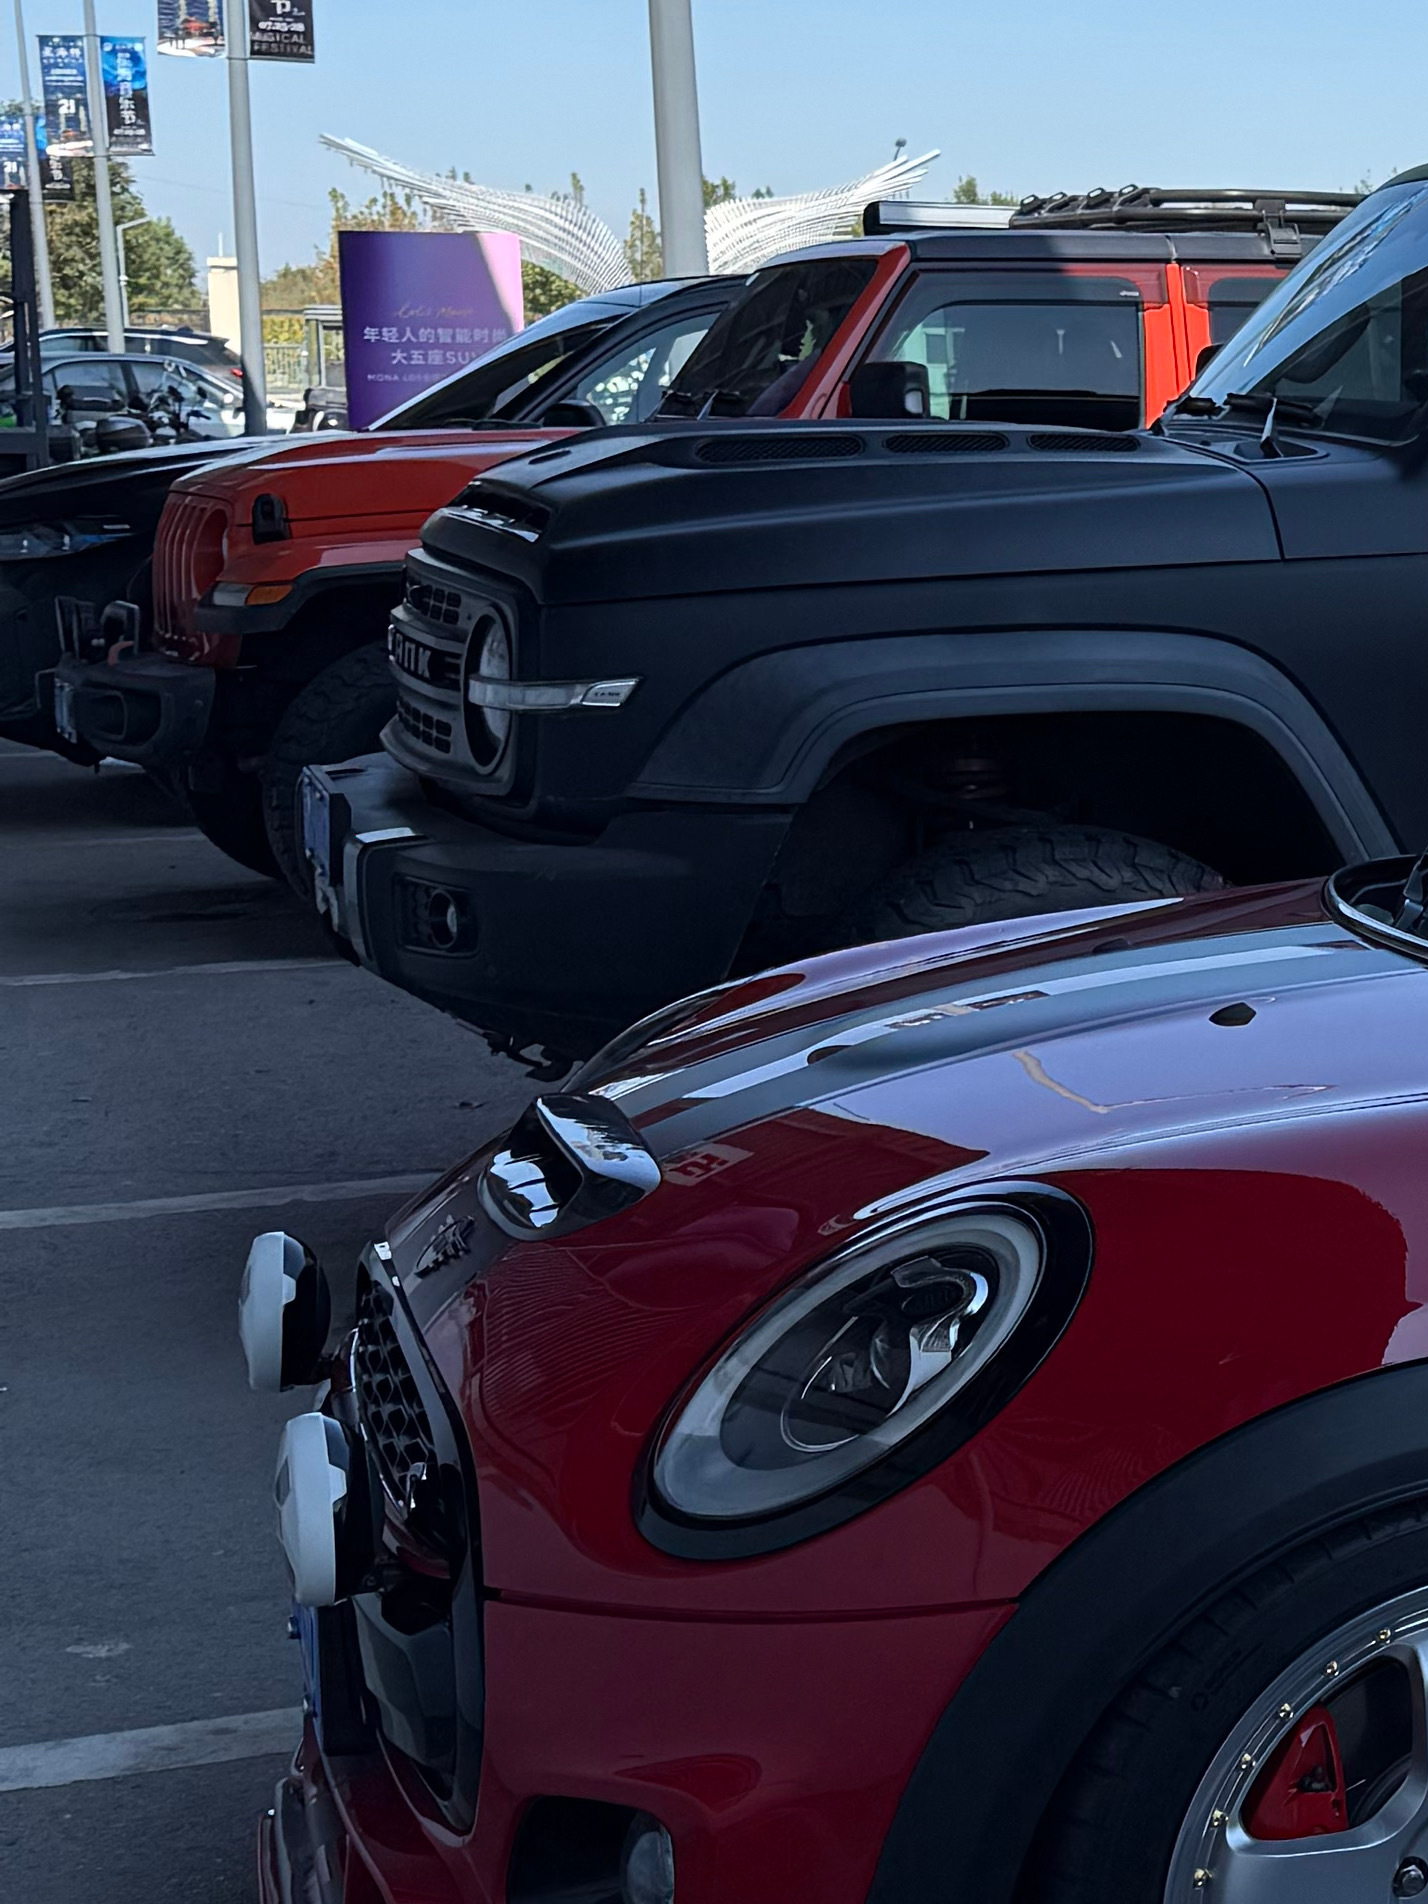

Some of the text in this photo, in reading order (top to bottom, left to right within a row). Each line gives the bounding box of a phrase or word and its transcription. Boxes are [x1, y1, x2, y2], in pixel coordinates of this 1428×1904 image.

[363, 326, 507, 344] 年轻人的智能时尚
